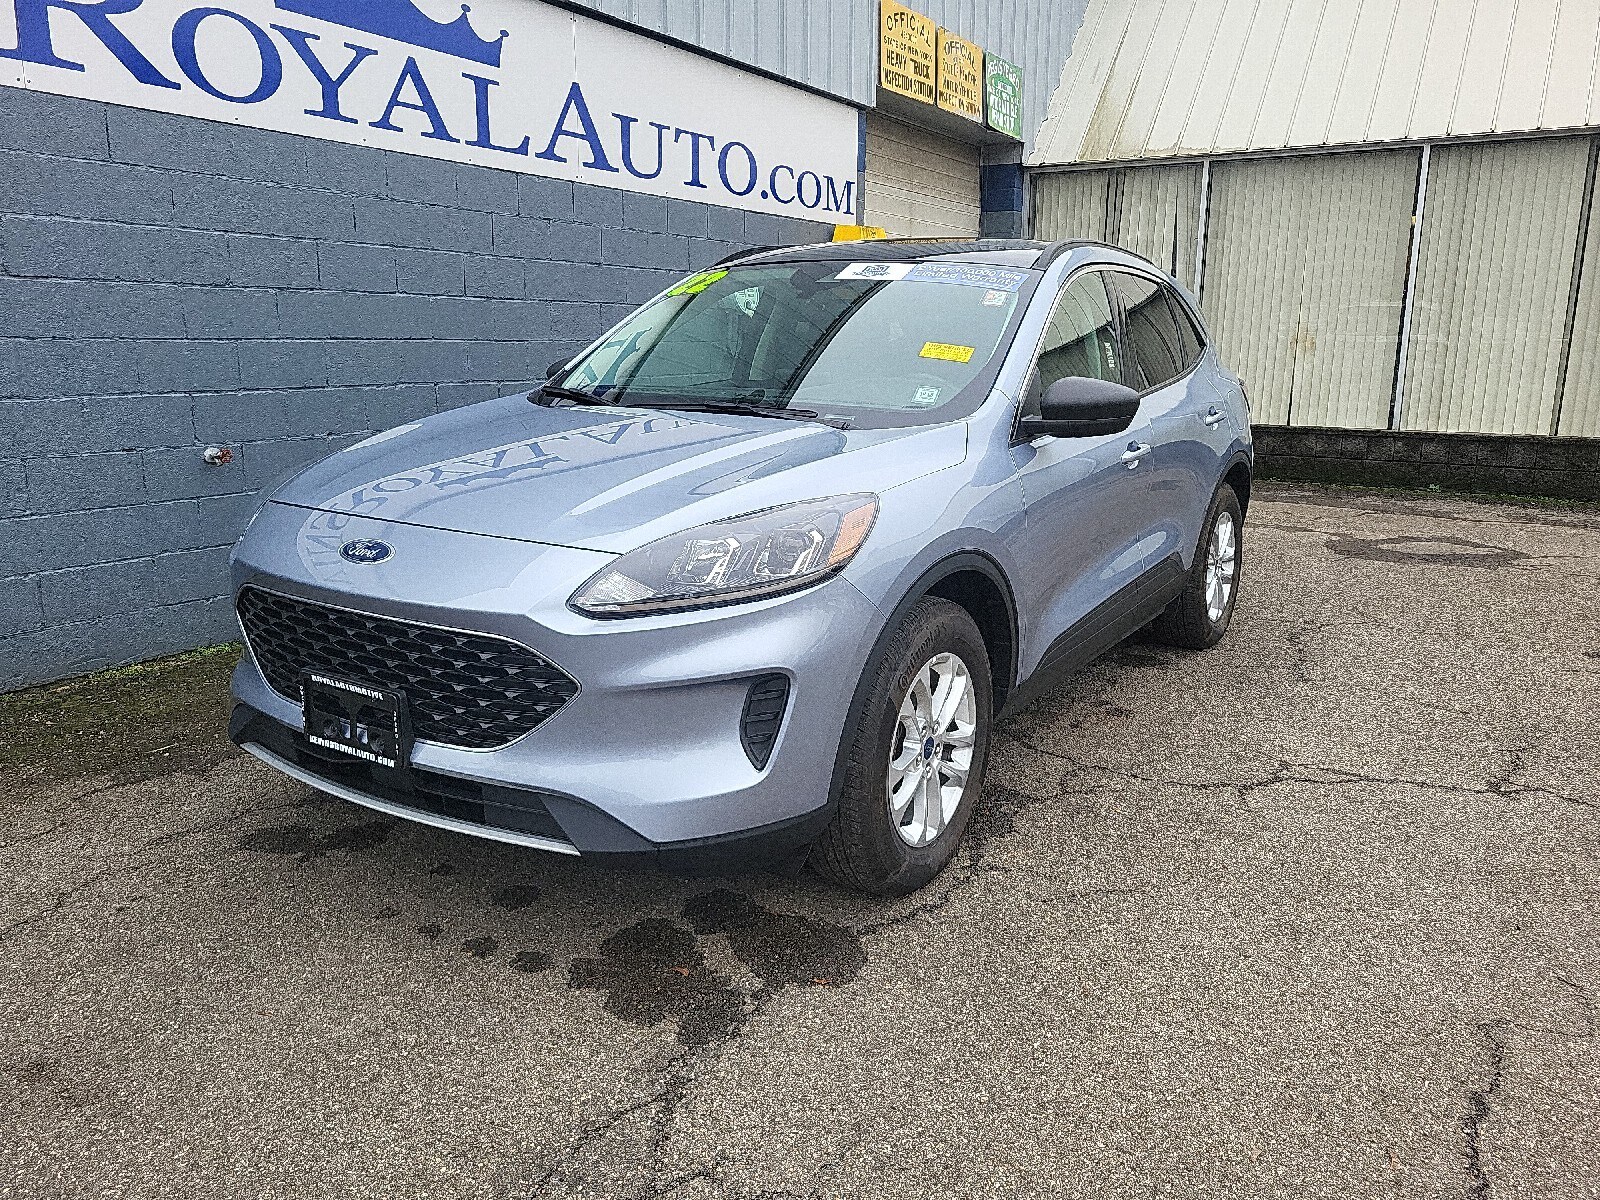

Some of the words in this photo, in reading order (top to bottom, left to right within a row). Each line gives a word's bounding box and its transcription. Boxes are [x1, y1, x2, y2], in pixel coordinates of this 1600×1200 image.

[886, 11, 931, 48] OFFICIAL
[886, 50, 907, 71] HEAVY
[910, 58, 931, 80] TRUCK
[944, 41, 977, 72] OFFICIAL
[962, 272, 1019, 287] Warranty
[346, 541, 382, 558] Ford
